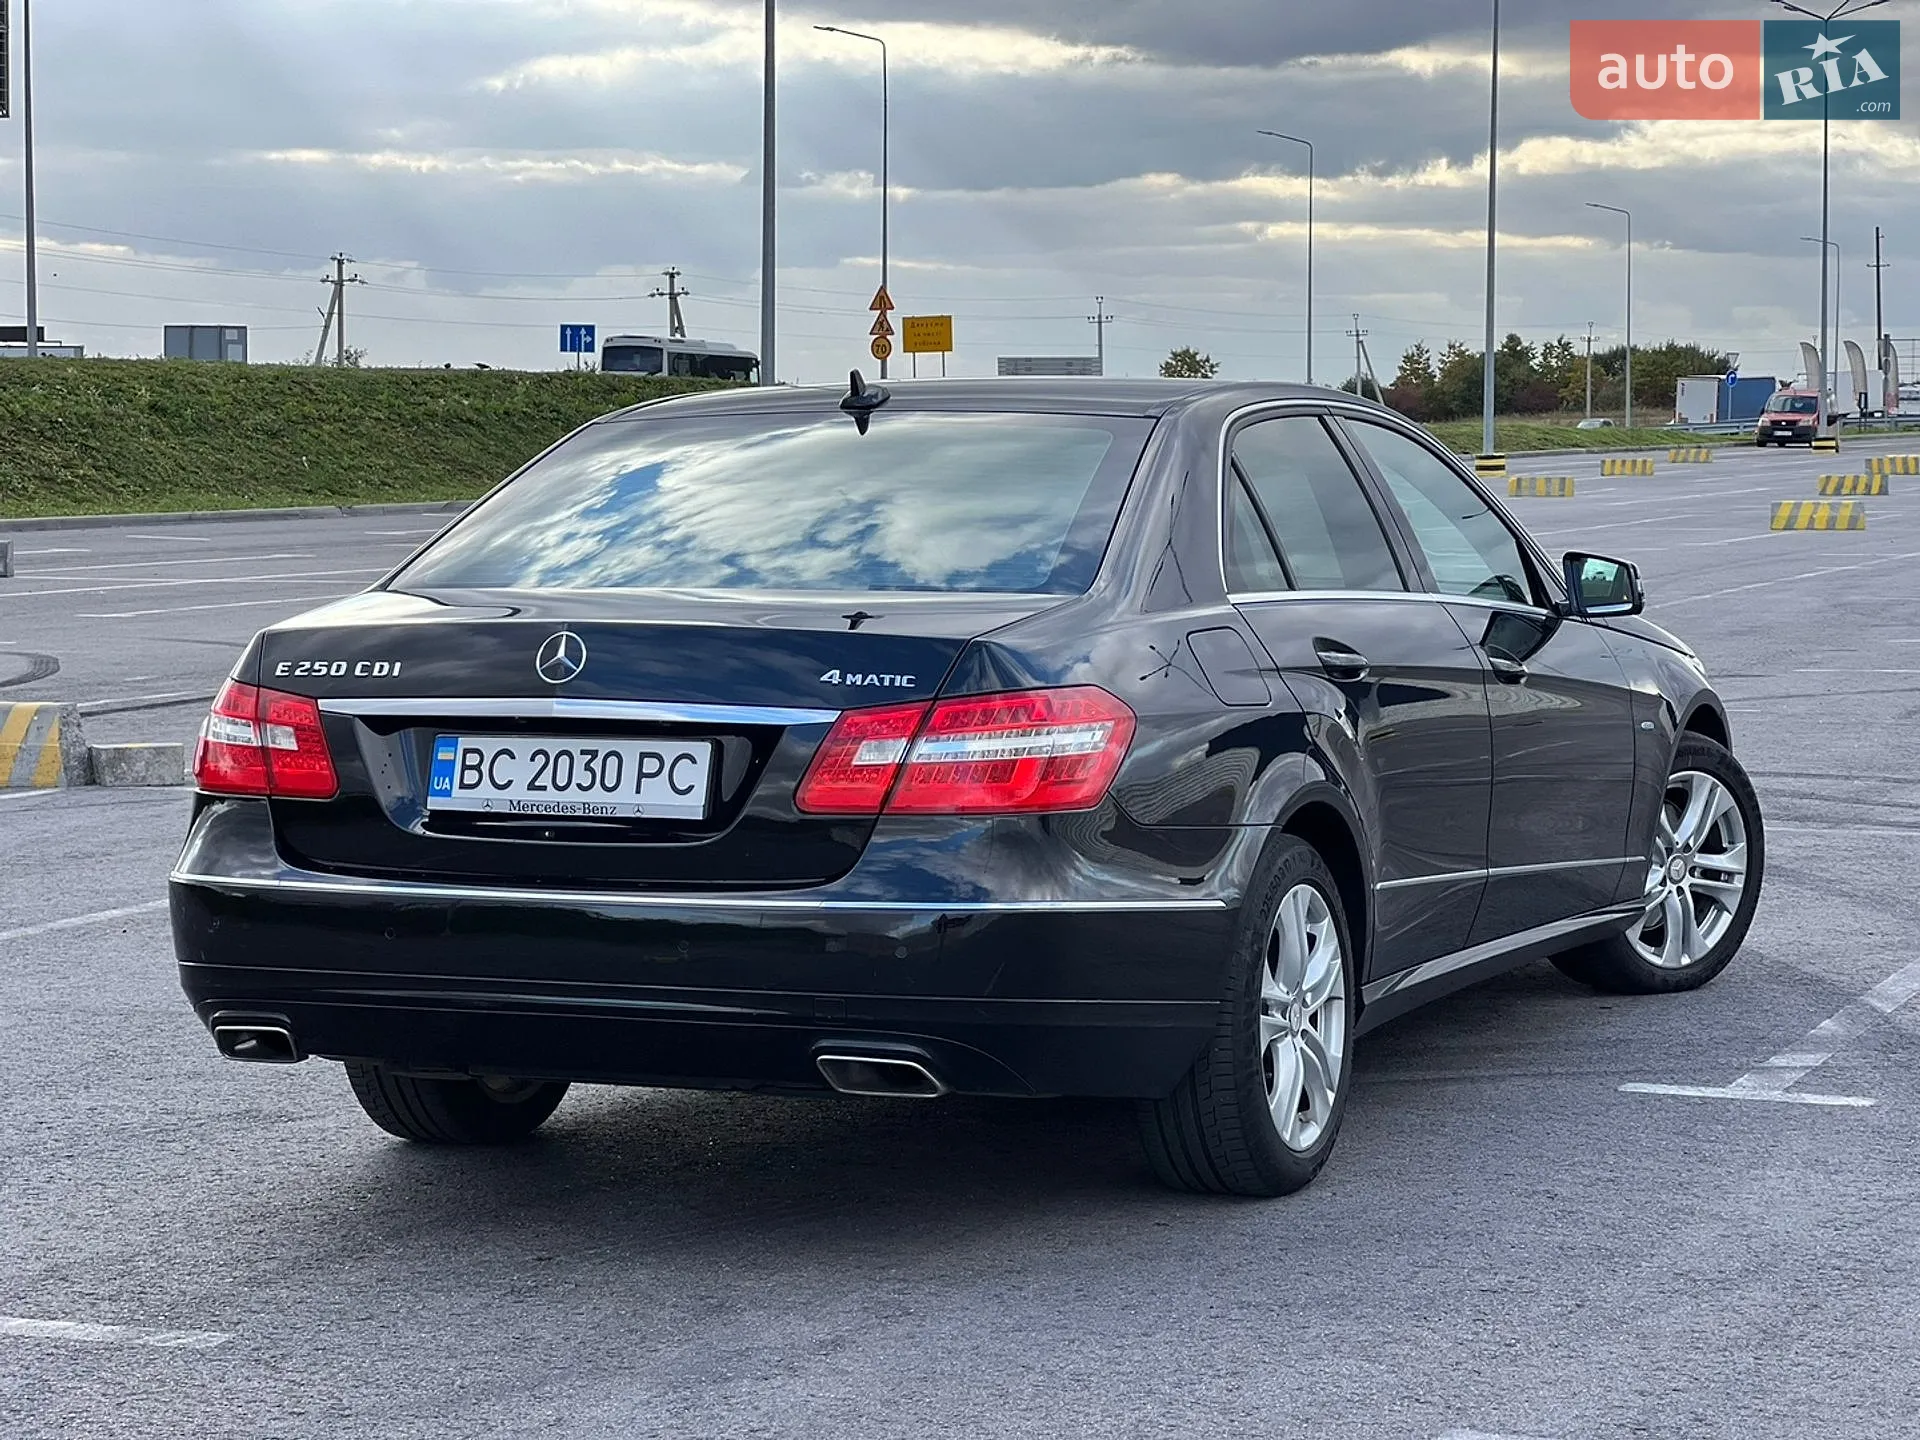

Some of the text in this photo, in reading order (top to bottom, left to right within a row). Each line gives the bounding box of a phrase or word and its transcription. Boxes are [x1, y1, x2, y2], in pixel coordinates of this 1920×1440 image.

[875, 343, 888, 355] 70
[275, 661, 401, 677] E 250 CDI
[458, 748, 698, 796] BC 2030 PC
[434, 777, 450, 791] UA
[508, 799, 617, 816] Mercedes-Benz
